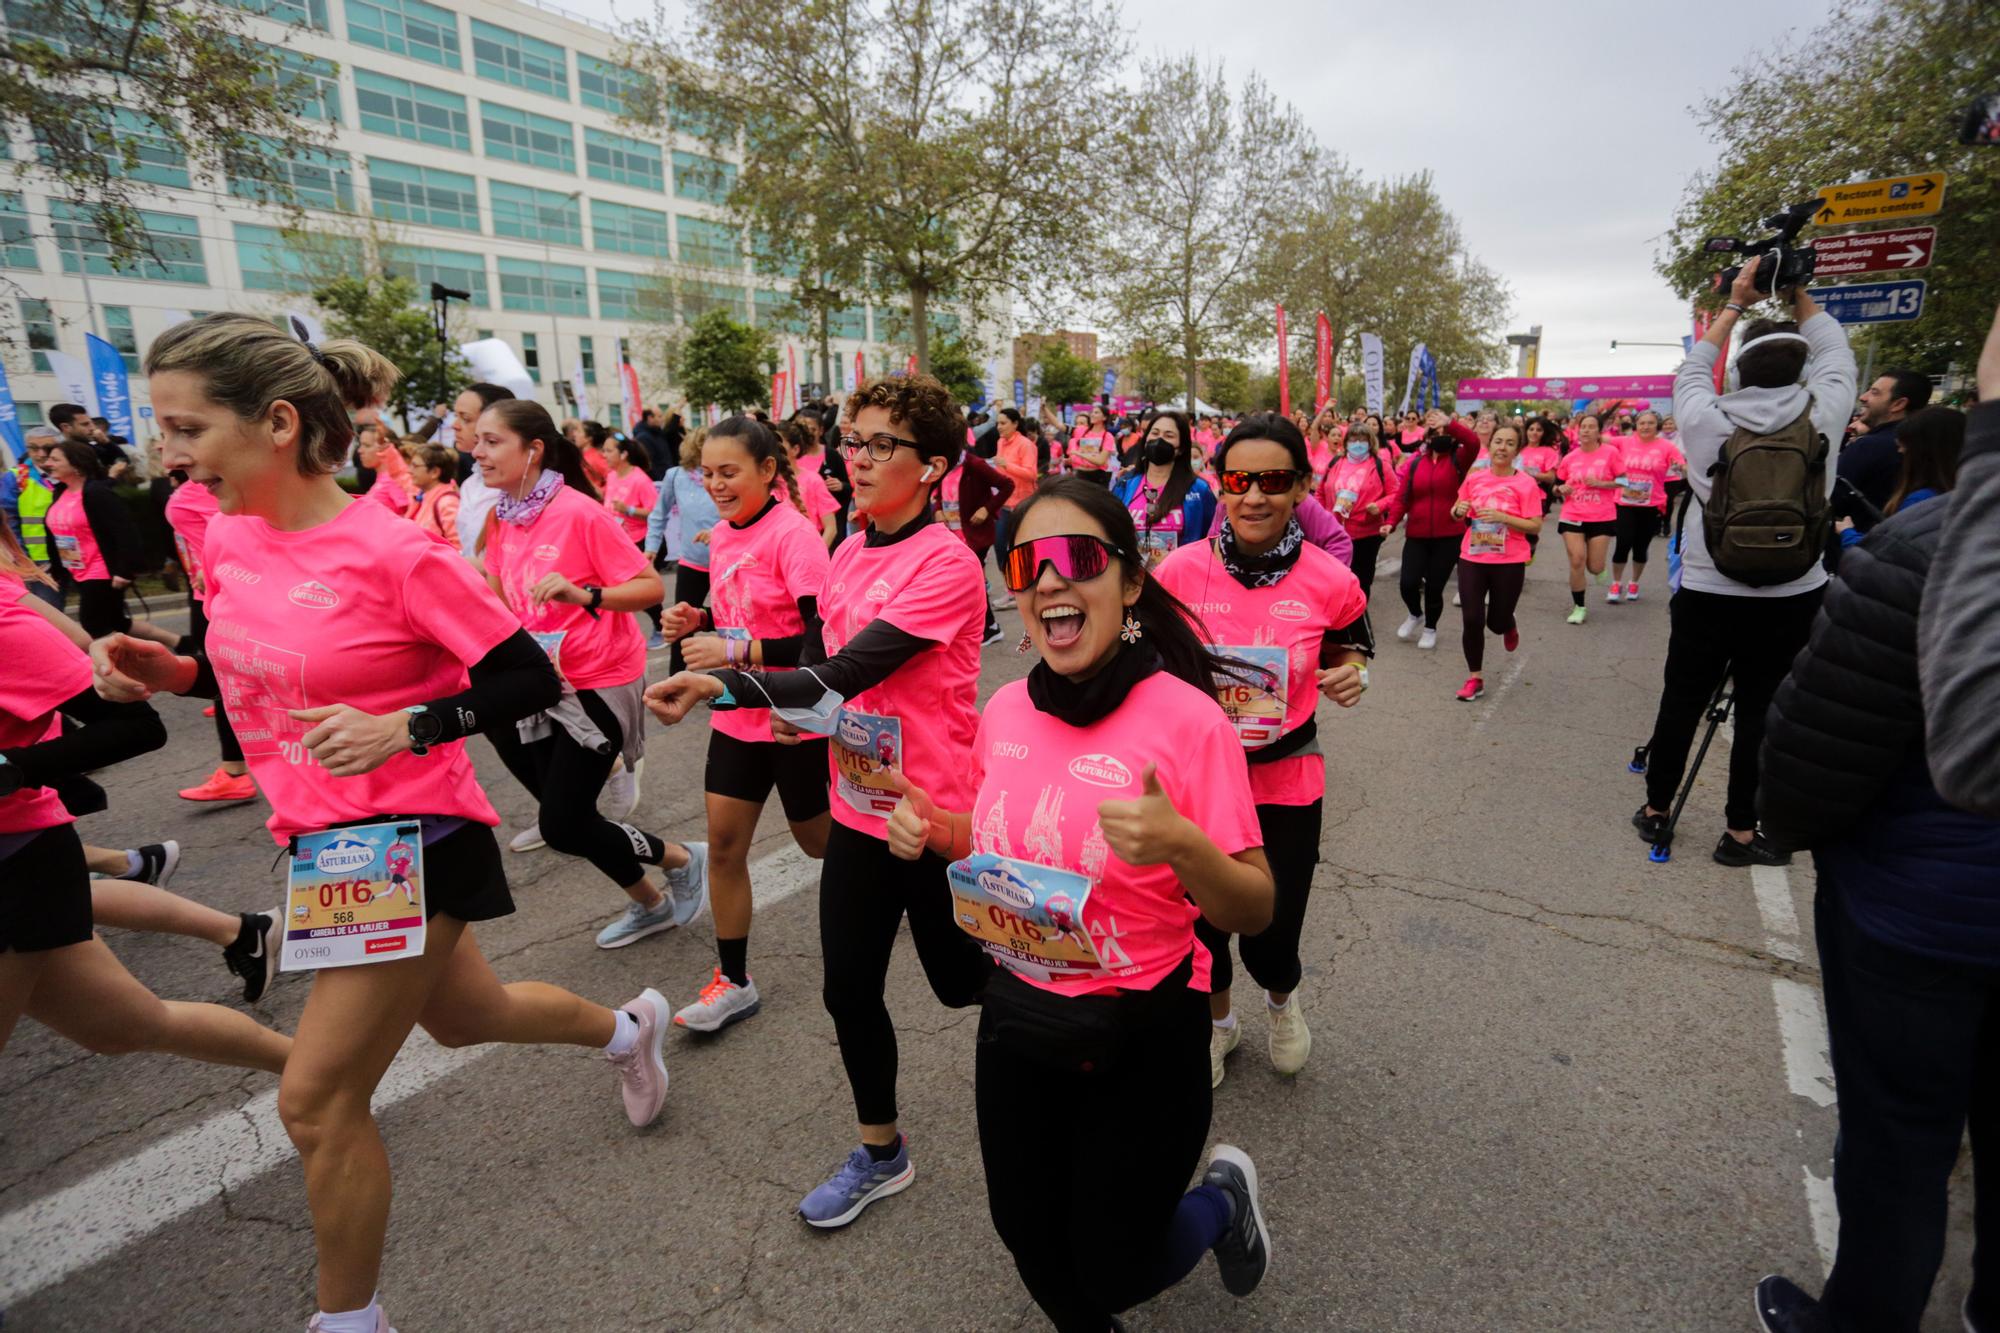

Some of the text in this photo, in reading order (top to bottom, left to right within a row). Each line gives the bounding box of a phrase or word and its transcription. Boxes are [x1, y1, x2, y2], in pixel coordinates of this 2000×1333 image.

[1835, 187, 1884, 201] Rectorat
[1843, 201, 1925, 218] Altres centres
[1814, 239, 1846, 251] Escola
[1888, 231, 1933, 245] Superior
[1886, 287, 1920, 315] 13
[1218, 685, 1251, 704] 16
[278, 740, 322, 767] 201
[1072, 760, 1126, 785] ASTURIANA
[319, 853, 371, 868] ASTURIANA
[319, 879, 373, 908] 016
[982, 877, 1031, 907] ASTURIANA
[333, 911, 354, 924] 568
[988, 904, 1042, 942] 016
[309, 922, 390, 938] CARRERA DE LA MUJER
[294, 946, 331, 960] OYSHO
[1009, 937, 1031, 952] 837
[1017, 950, 1029, 961] DE
[1028, 953, 1040, 963] LA
[1039, 956, 1069, 968] MUJER
